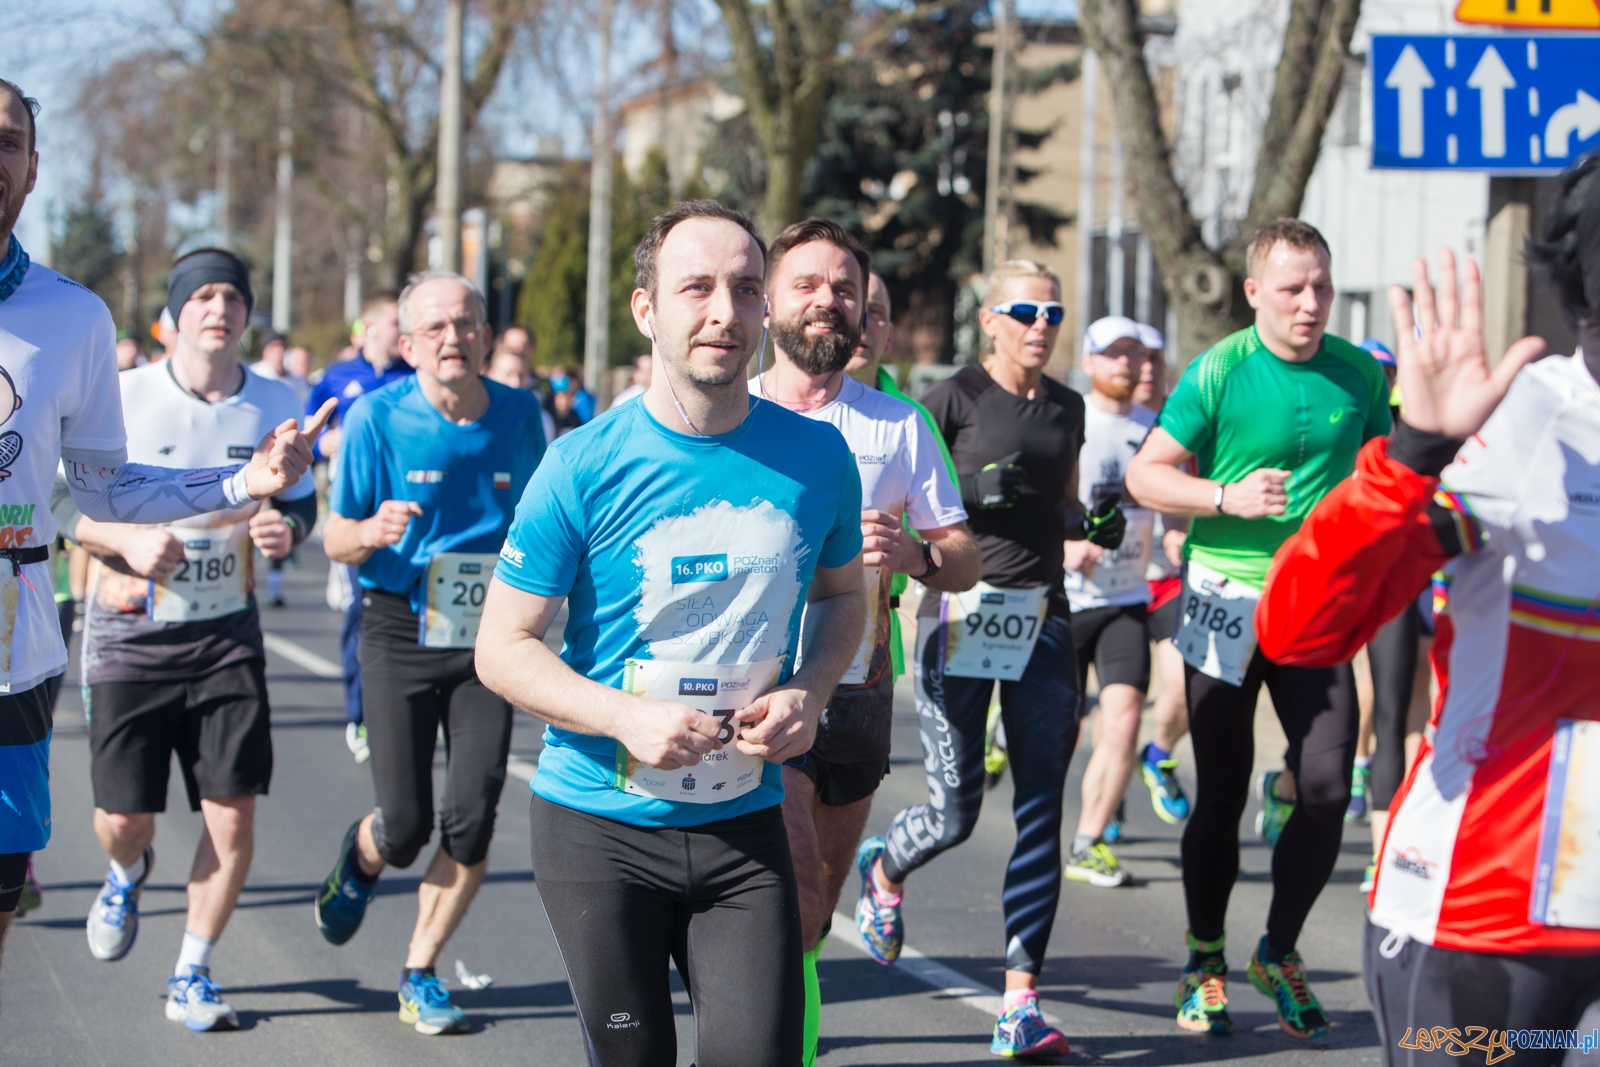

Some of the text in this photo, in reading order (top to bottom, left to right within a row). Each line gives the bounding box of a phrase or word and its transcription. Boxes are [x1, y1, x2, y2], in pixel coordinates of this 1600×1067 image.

[173, 552, 236, 583] 2180
[675, 560, 725, 576] 16. PKO
[733, 565, 778, 575] maraton
[675, 595, 715, 611] SIŁA
[686, 611, 769, 628] ODWAGA
[1186, 595, 1243, 640] 8186
[966, 611, 1038, 641] 9607
[672, 626, 769, 646] SZYBKOŚĆ
[682, 681, 715, 692] 10. PKO
[606, 1020, 641, 1030] Kalenji
